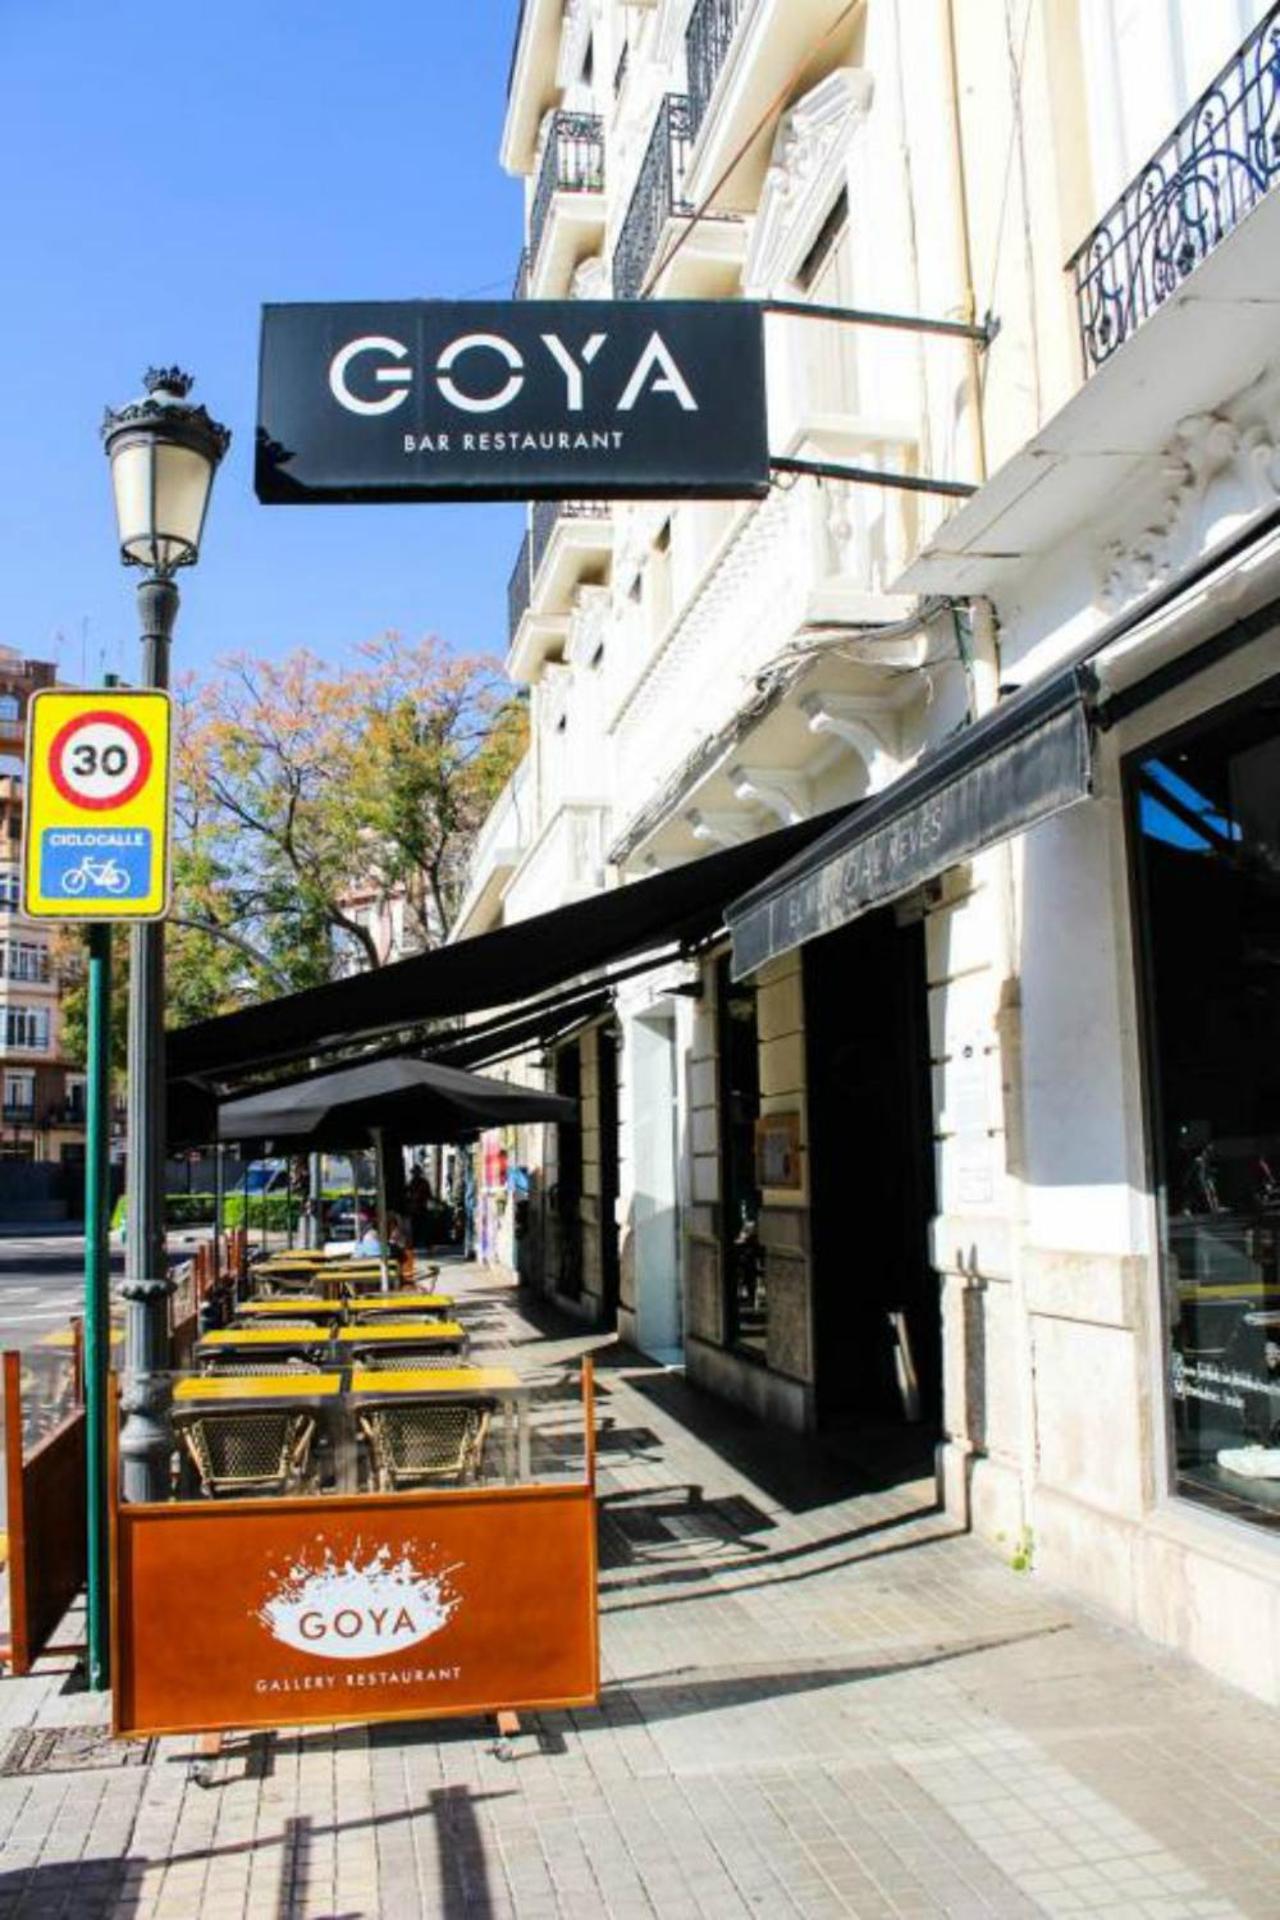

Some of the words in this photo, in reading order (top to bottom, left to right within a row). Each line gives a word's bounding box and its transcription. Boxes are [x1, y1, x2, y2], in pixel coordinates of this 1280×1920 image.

[329, 331, 699, 416] GOYA
[403, 433, 450, 453] BAR
[463, 431, 625, 452] RESTAURANT
[71, 744, 129, 777] 30
[49, 830, 144, 847] CICLOCALLE
[299, 1607, 416, 1640] GOYA
[255, 1674, 336, 1695] GALLERY
[346, 1666, 462, 1688] RESTAURANT
